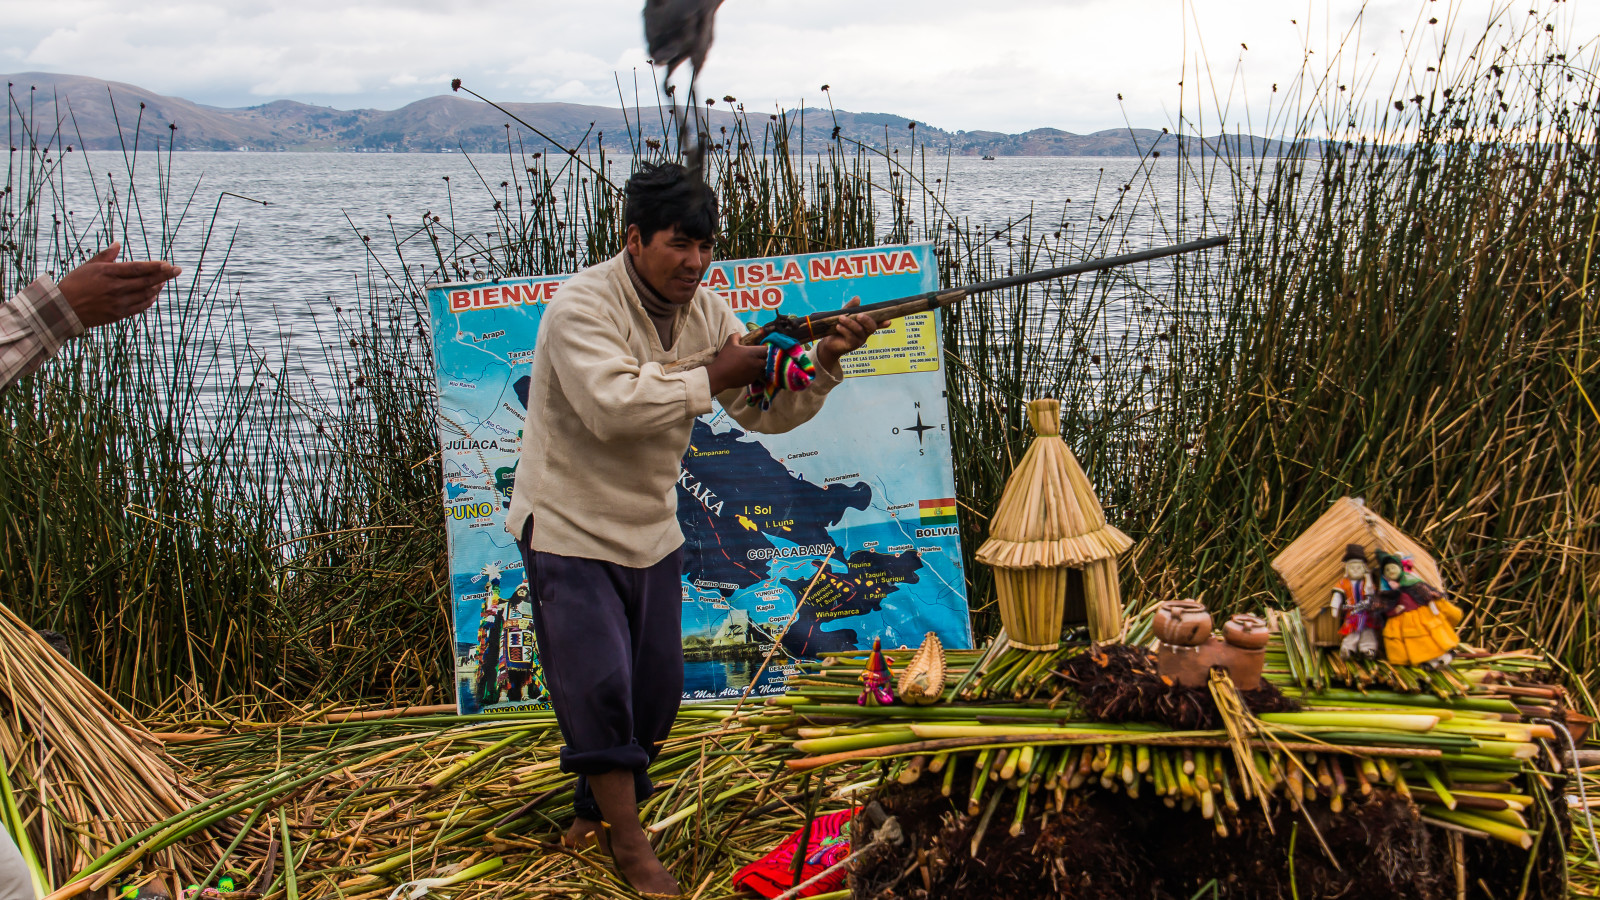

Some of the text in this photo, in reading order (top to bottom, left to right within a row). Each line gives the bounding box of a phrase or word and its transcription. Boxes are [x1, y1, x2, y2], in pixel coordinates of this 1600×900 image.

[451, 252, 919, 309] BIENVE A ISLA NATIVA
[482, 329, 505, 341] Arapa
[914, 401, 921, 409] N
[892, 424, 946, 435] O E
[446, 440, 499, 450] JULIACA
[693, 449, 730, 458] Campanario
[787, 450, 819, 460] Carabuco
[919, 449, 925, 457] S
[823, 472, 860, 484] Ancoraimes
[444, 502, 494, 520] PUNO
[744, 505, 772, 515] I. Sol
[772, 519, 794, 528] Luna
[916, 526, 960, 538] BOLIVIA
[747, 543, 835, 561] COPACABANA
[508, 560, 524, 569] Cuti
[847, 562, 872, 570] Tiquina
[864, 571, 887, 579] Taquiri
[881, 575, 906, 584] Suriqui
[815, 589, 834, 604] Anapia
[694, 689, 716, 699] Mas
[719, 687, 739, 698] Alto
[758, 684, 791, 694] Mundo
[517, 703, 545, 712] CAPAC
